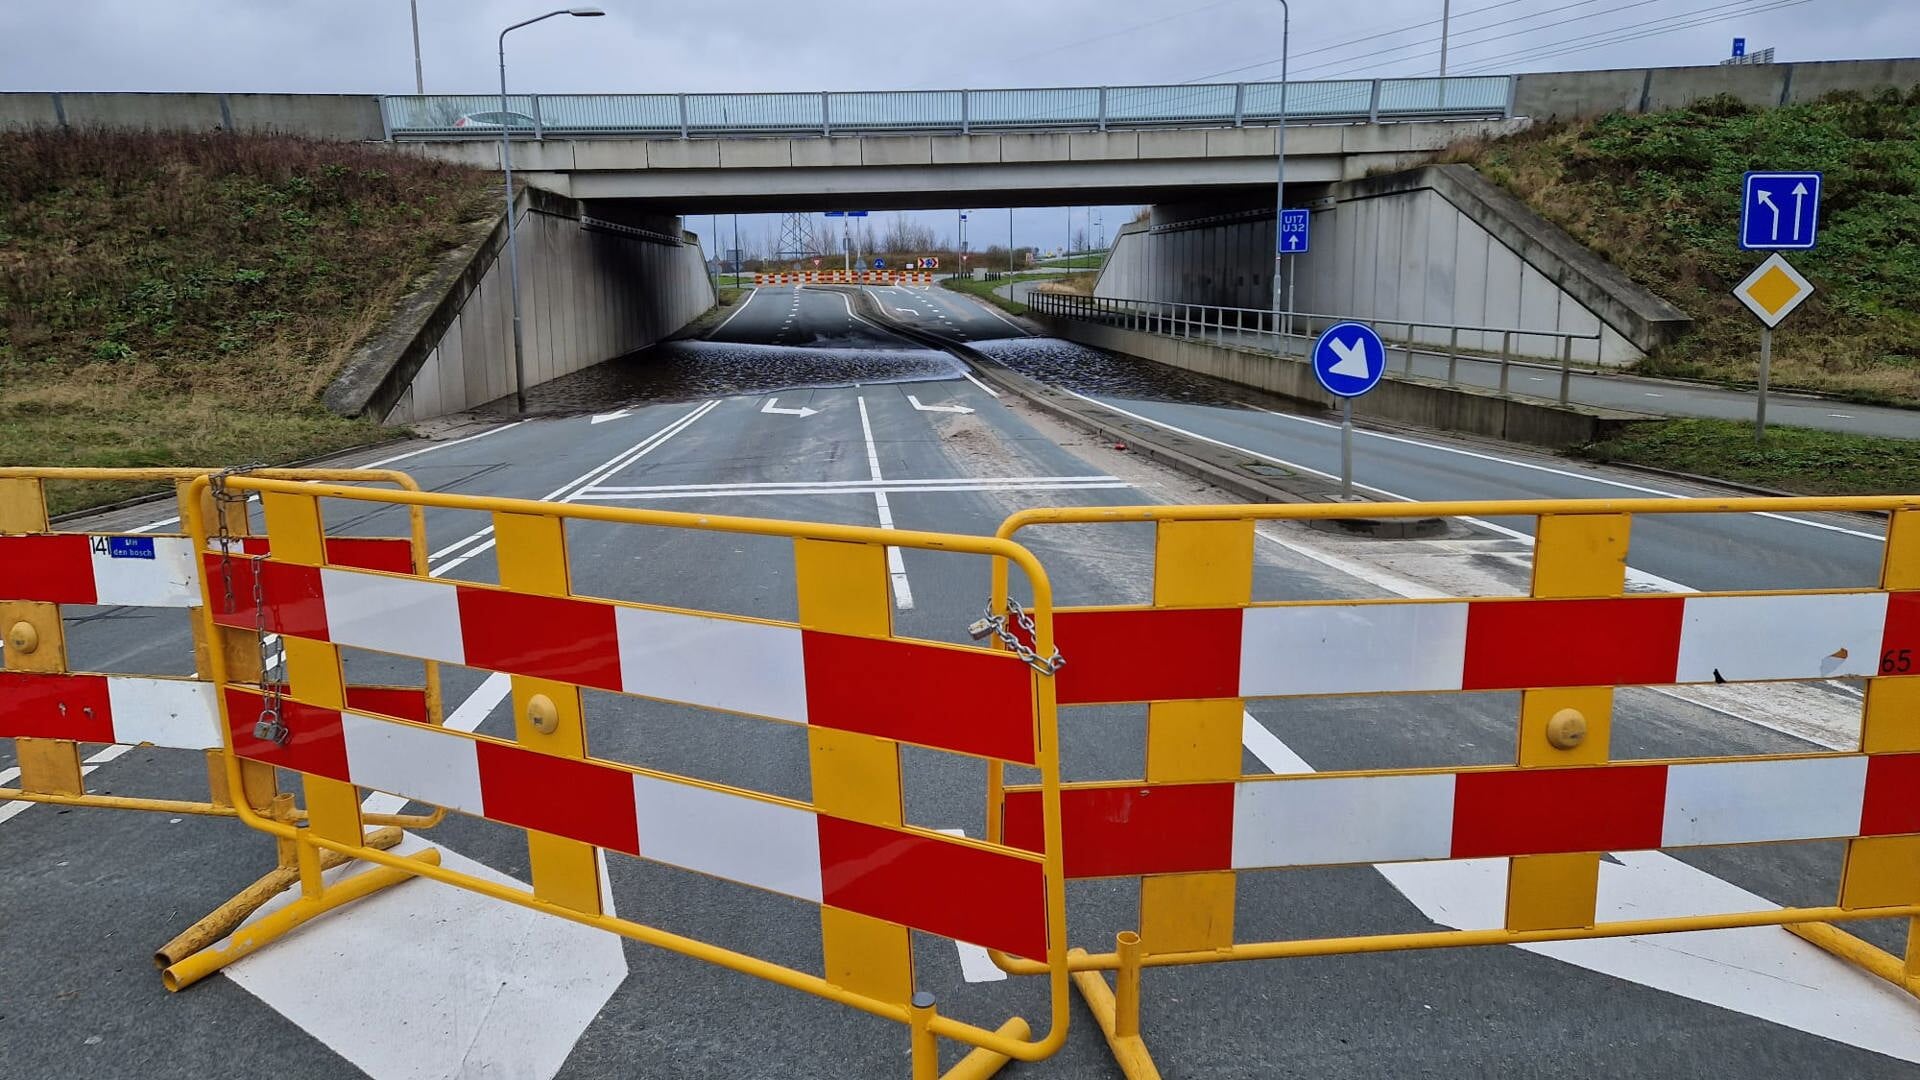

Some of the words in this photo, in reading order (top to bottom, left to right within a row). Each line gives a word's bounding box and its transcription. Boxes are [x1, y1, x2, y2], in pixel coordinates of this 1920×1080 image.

[1285, 215, 1303, 224] U17
[1283, 224, 1305, 233] U32
[90, 536, 111, 555] 141
[129, 548, 153, 558] bosch
[1883, 649, 1912, 673] 65
